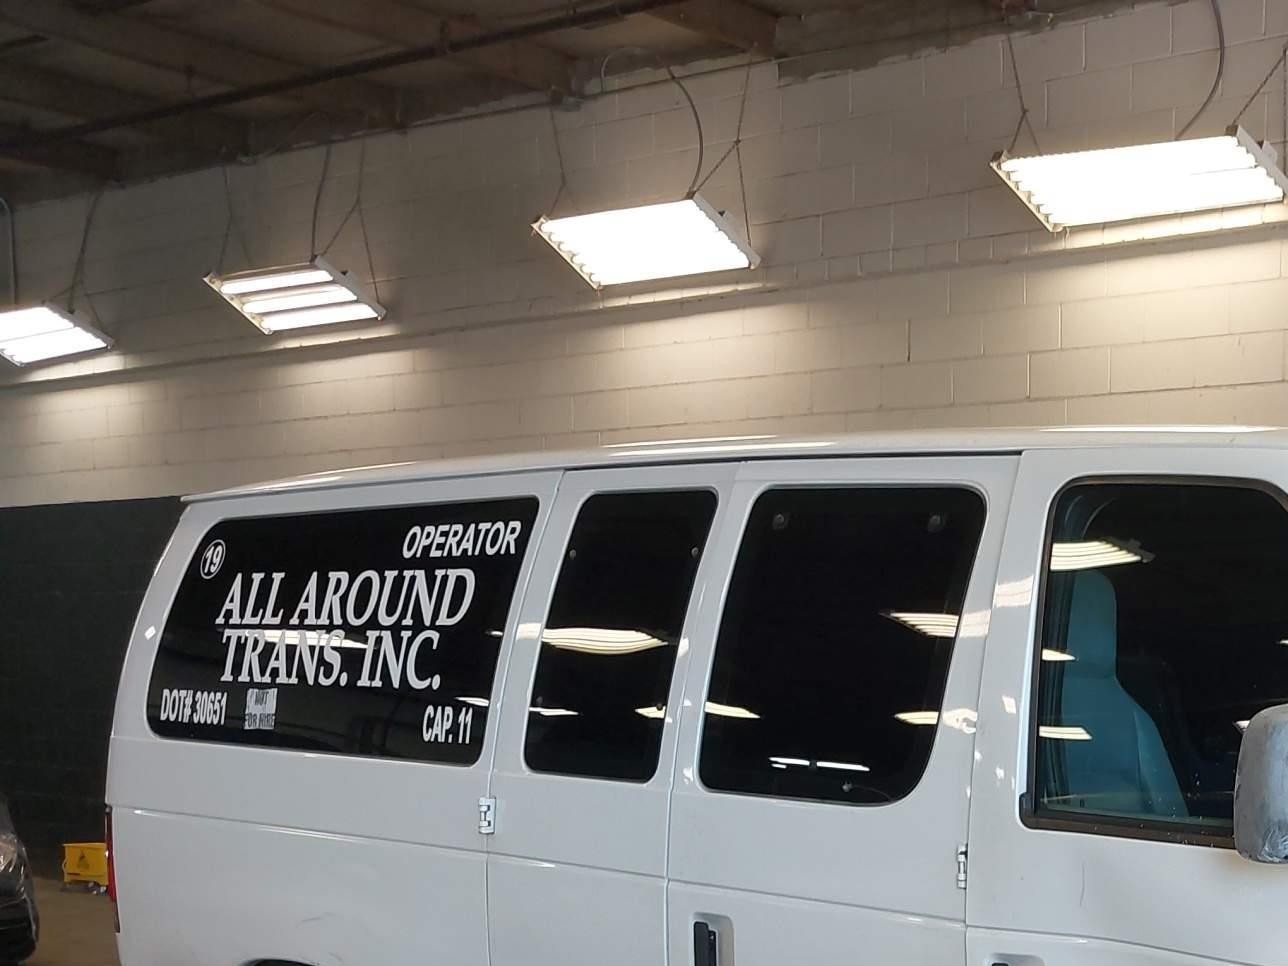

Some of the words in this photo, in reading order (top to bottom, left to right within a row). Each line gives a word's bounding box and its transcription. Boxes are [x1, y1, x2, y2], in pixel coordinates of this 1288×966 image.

[402, 520, 521, 558] OPERATOR
[204, 545, 223, 573] 19
[215, 572, 286, 624] ALL
[289, 568, 476, 626] AROUND
[220, 629, 348, 687] TRANS.
[357, 630, 441, 690] INC.
[160, 688, 193, 723] DOT#
[193, 690, 228, 725] 30651
[423, 704, 454, 743] CAP.
[458, 707, 472, 744] 11
